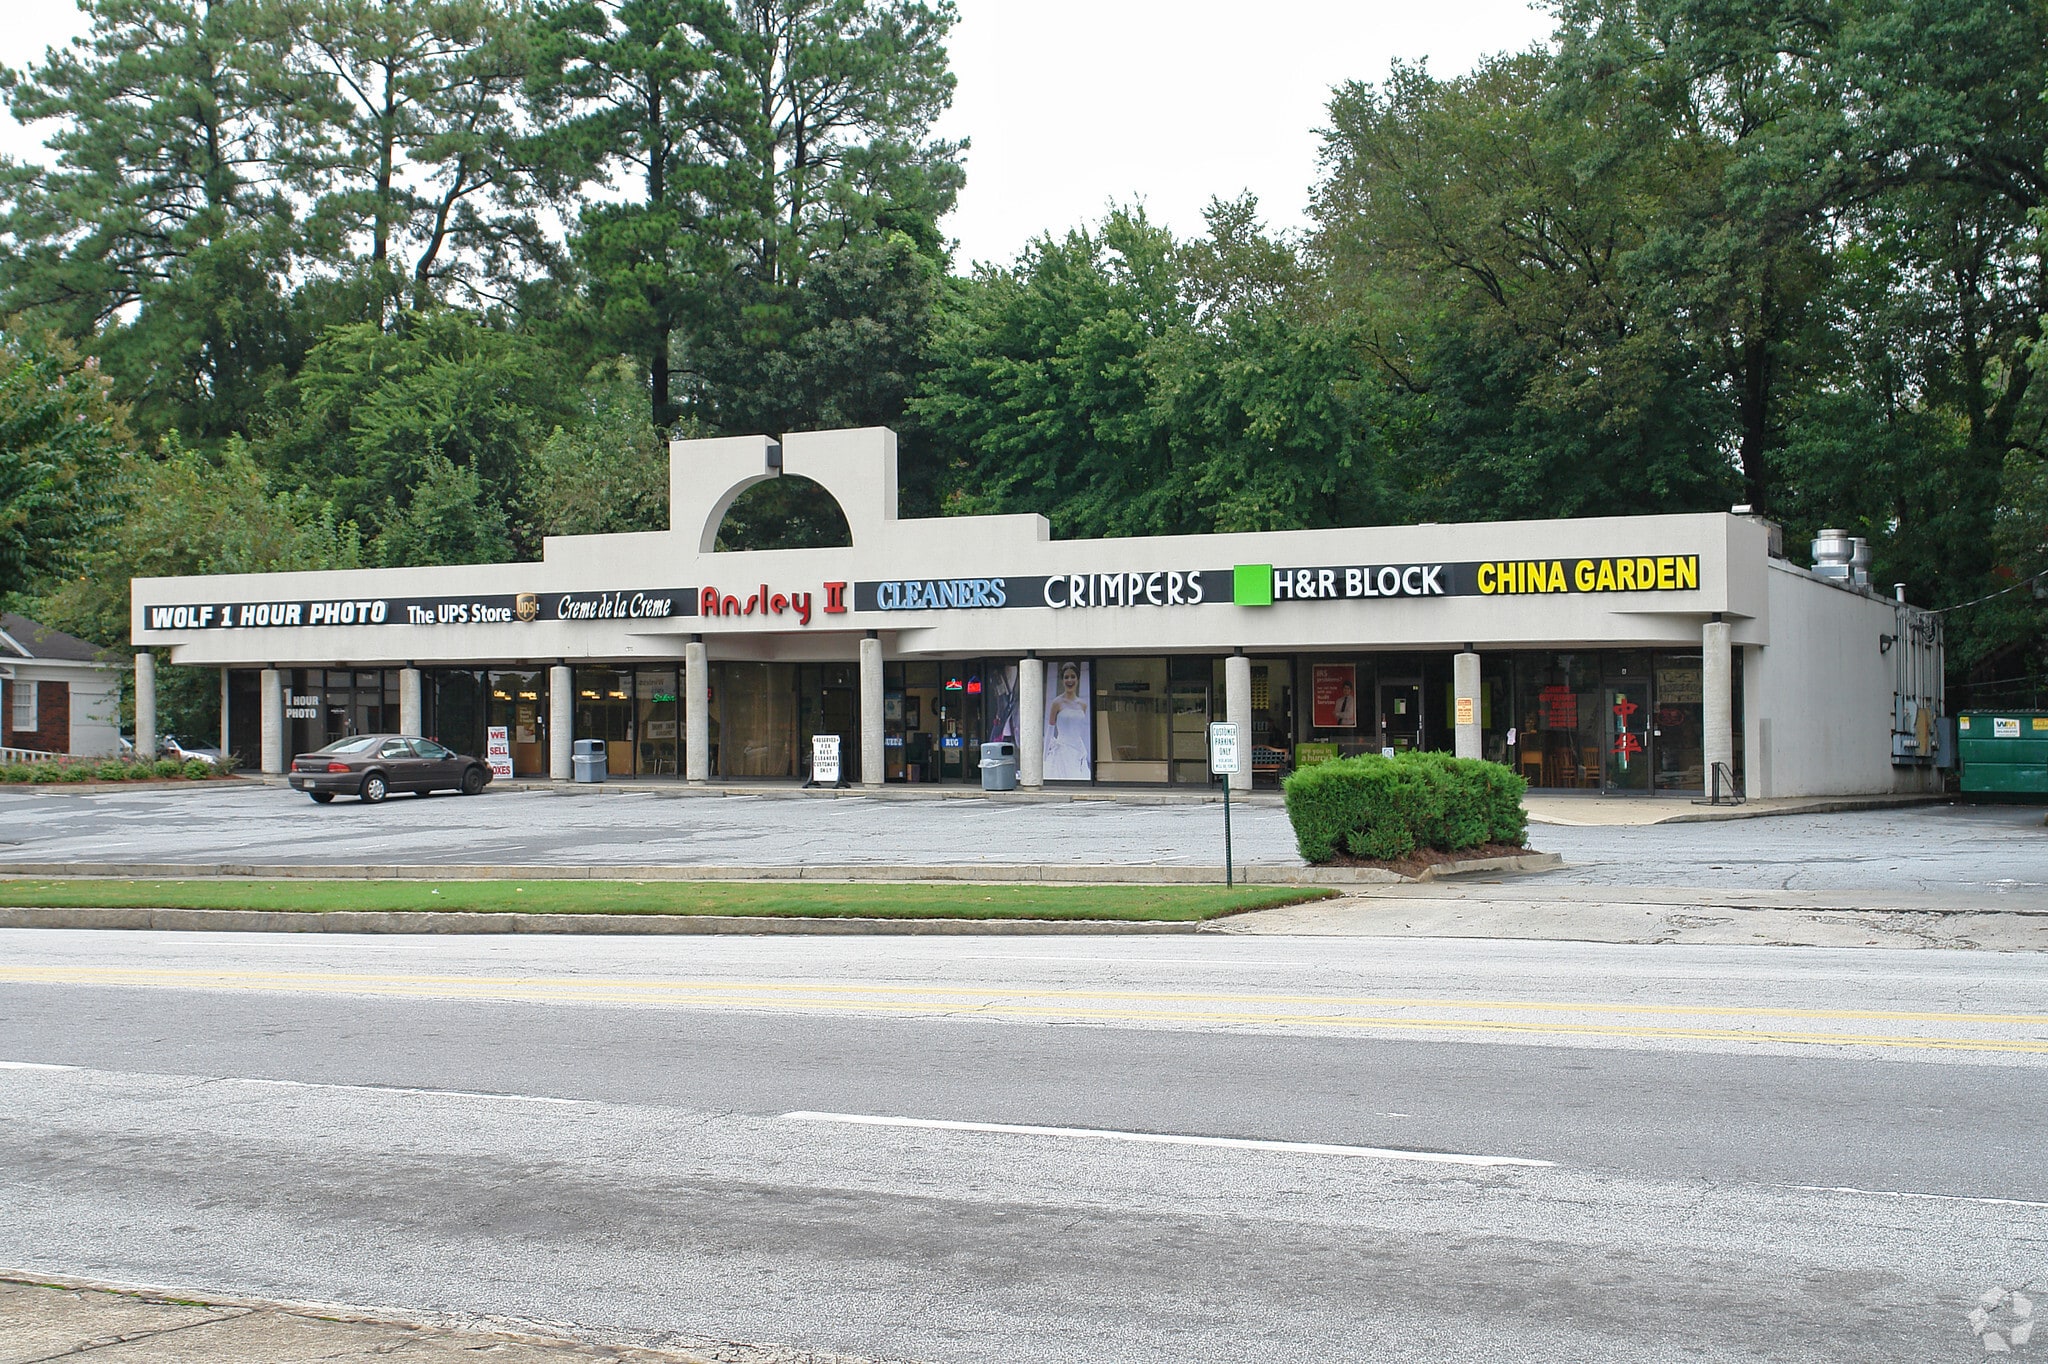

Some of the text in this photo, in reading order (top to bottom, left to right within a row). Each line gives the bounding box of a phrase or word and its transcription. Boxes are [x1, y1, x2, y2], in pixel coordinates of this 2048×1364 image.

[1274, 565, 1444, 599] H&R BLOCK
[1477, 556, 1697, 595] CHINA GARDEN
[877, 579, 1006, 610] CLEANERS
[1043, 571, 1204, 608] CRIMPERS
[407, 603, 513, 624] The UPS Store
[557, 592, 671, 619] Creme de la Creme
[701, 581, 847, 625] Ansley II
[152, 600, 387, 629] WOLF 1 HOUR PHOTO
[283, 688, 319, 706] 1 HOUR
[286, 708, 316, 718] PHOTO
[490, 731, 505, 739] WE
[1215, 738, 1235, 746] PARKING
[490, 746, 507, 755] SELL
[1219, 747, 1231, 756] ONLY
[492, 765, 511, 774] OXES
